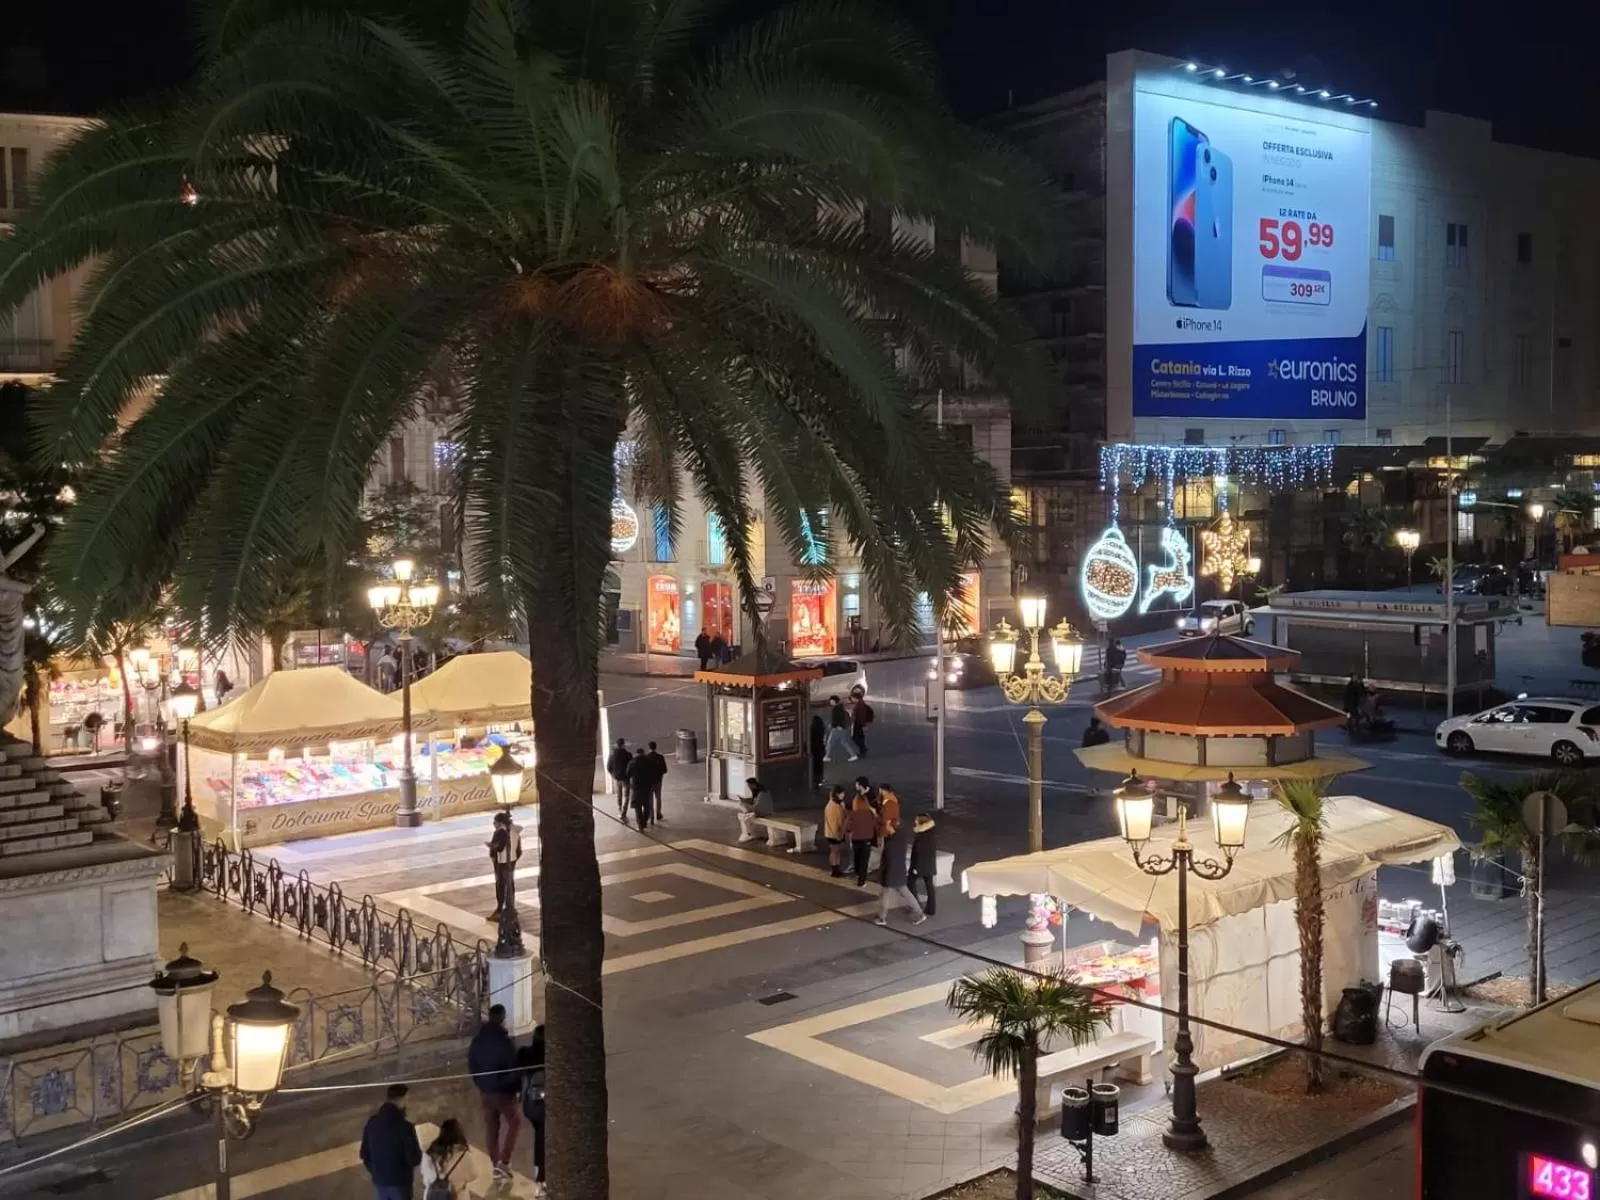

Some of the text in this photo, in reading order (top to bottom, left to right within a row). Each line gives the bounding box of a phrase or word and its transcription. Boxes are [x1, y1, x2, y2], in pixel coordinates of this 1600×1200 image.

[1262, 140, 1334, 161] OFFERTA ESCLUSIVA
[1286, 178, 1294, 187] 14
[1279, 207, 1317, 220] 12 RATE DA
[1183, 317, 1222, 332] iPhone 14
[1151, 358, 1252, 377] Catania via L. Rizzo
[1279, 355, 1358, 383] euronics
[1311, 389, 1358, 408] BRUNO
[1376, 603, 1433, 612] LA SICILIA
[271, 807, 353, 830] Dolciumi
[357, 790, 457, 822] Spainto
[463, 786, 493, 802] dal
[1535, 1161, 1591, 1200] 433
